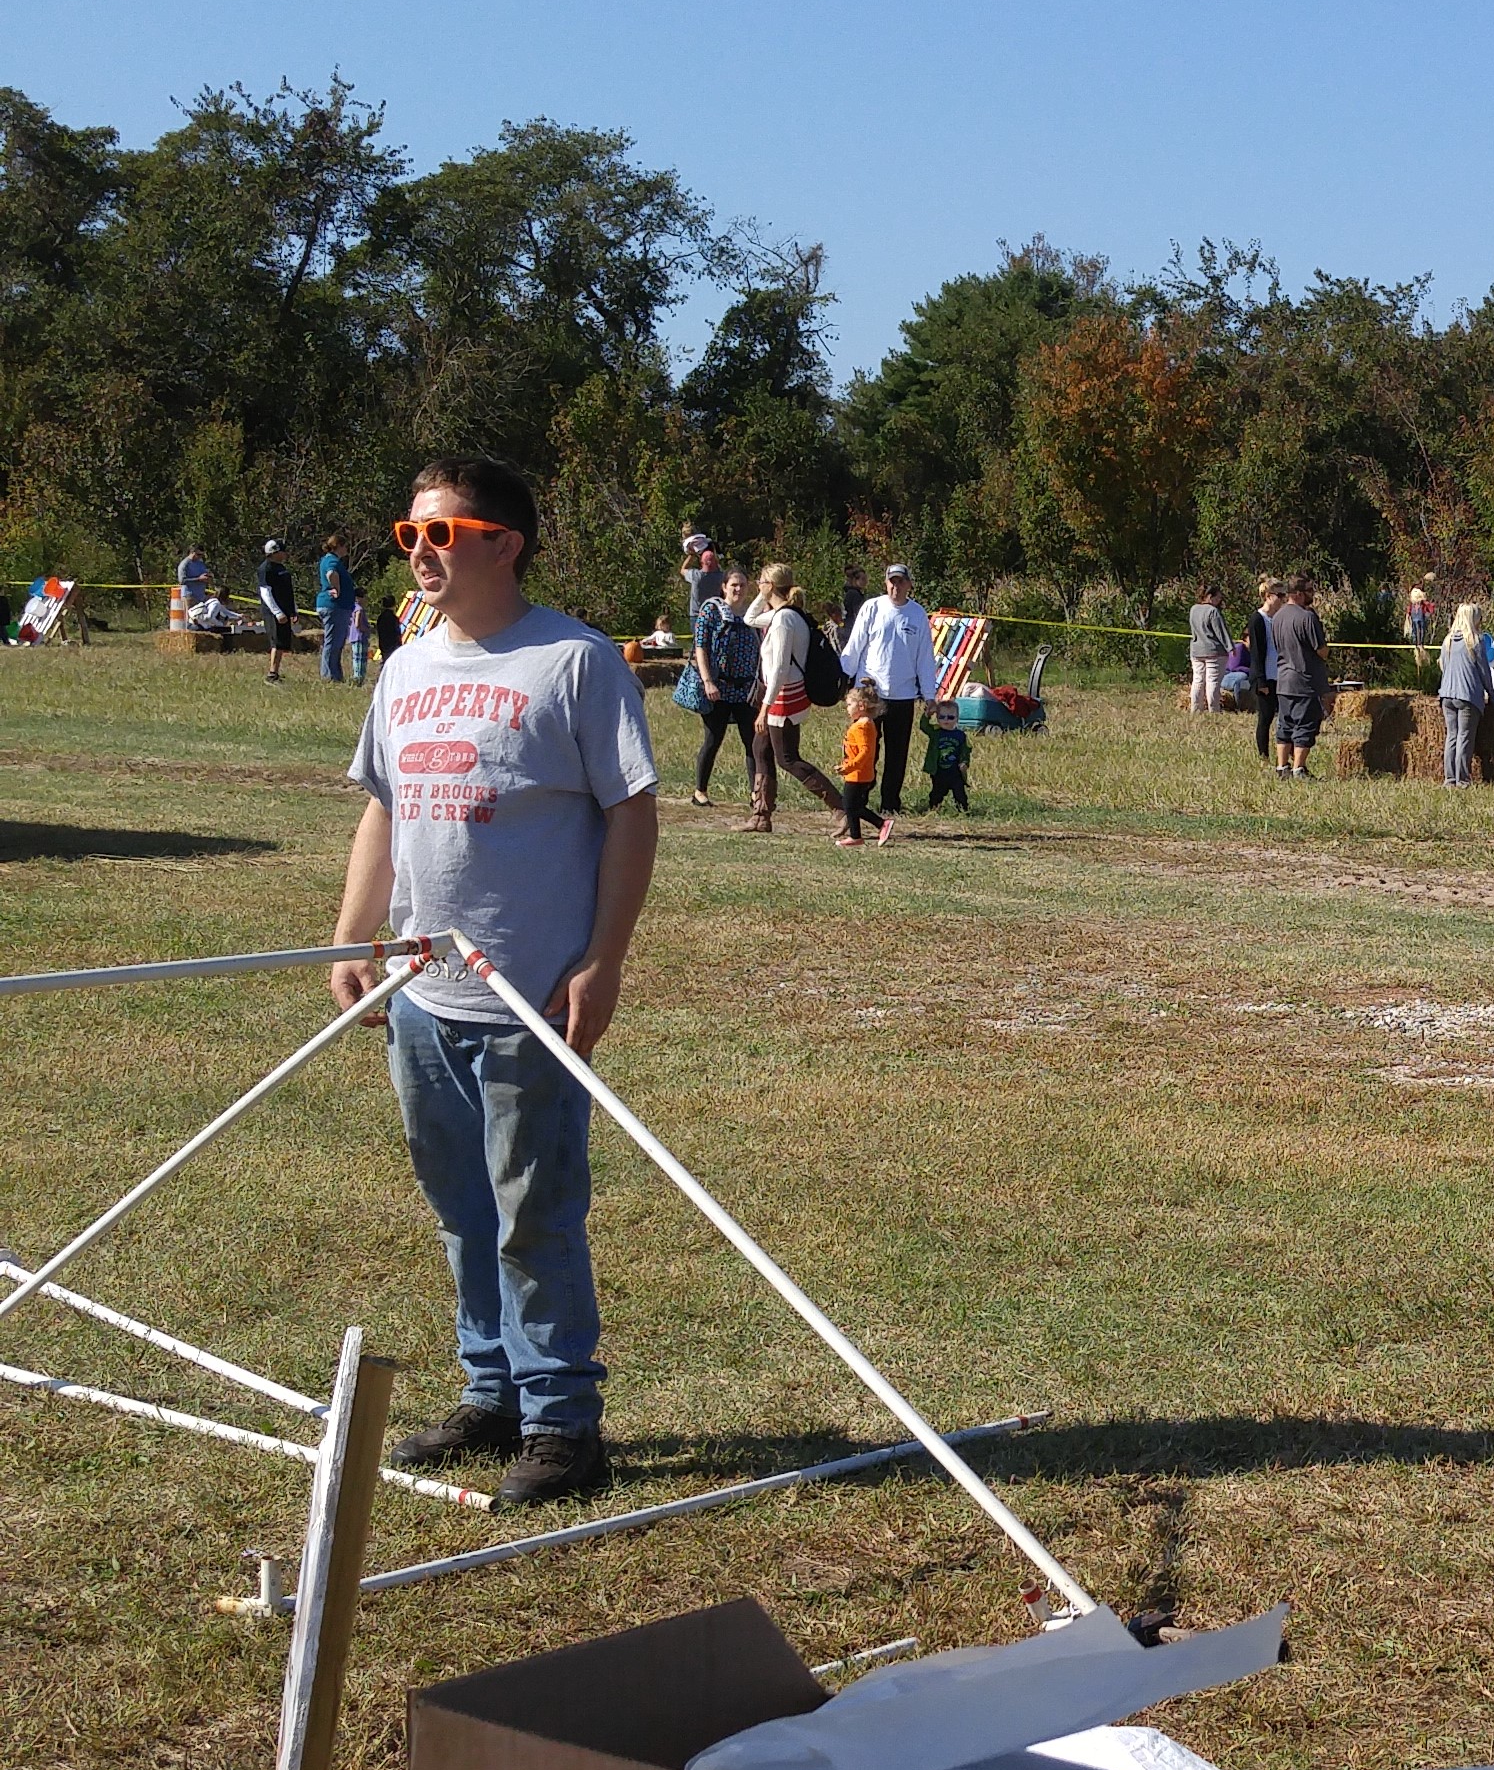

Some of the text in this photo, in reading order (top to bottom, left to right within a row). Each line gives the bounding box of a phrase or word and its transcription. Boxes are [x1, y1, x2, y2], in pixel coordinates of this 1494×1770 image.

[388, 683, 529, 736] PROPERTY
[435, 722, 456, 734] OF
[449, 752, 476, 763] TOUR
[430, 783, 498, 803] BROOKS
[431, 803, 496, 824] CREW
